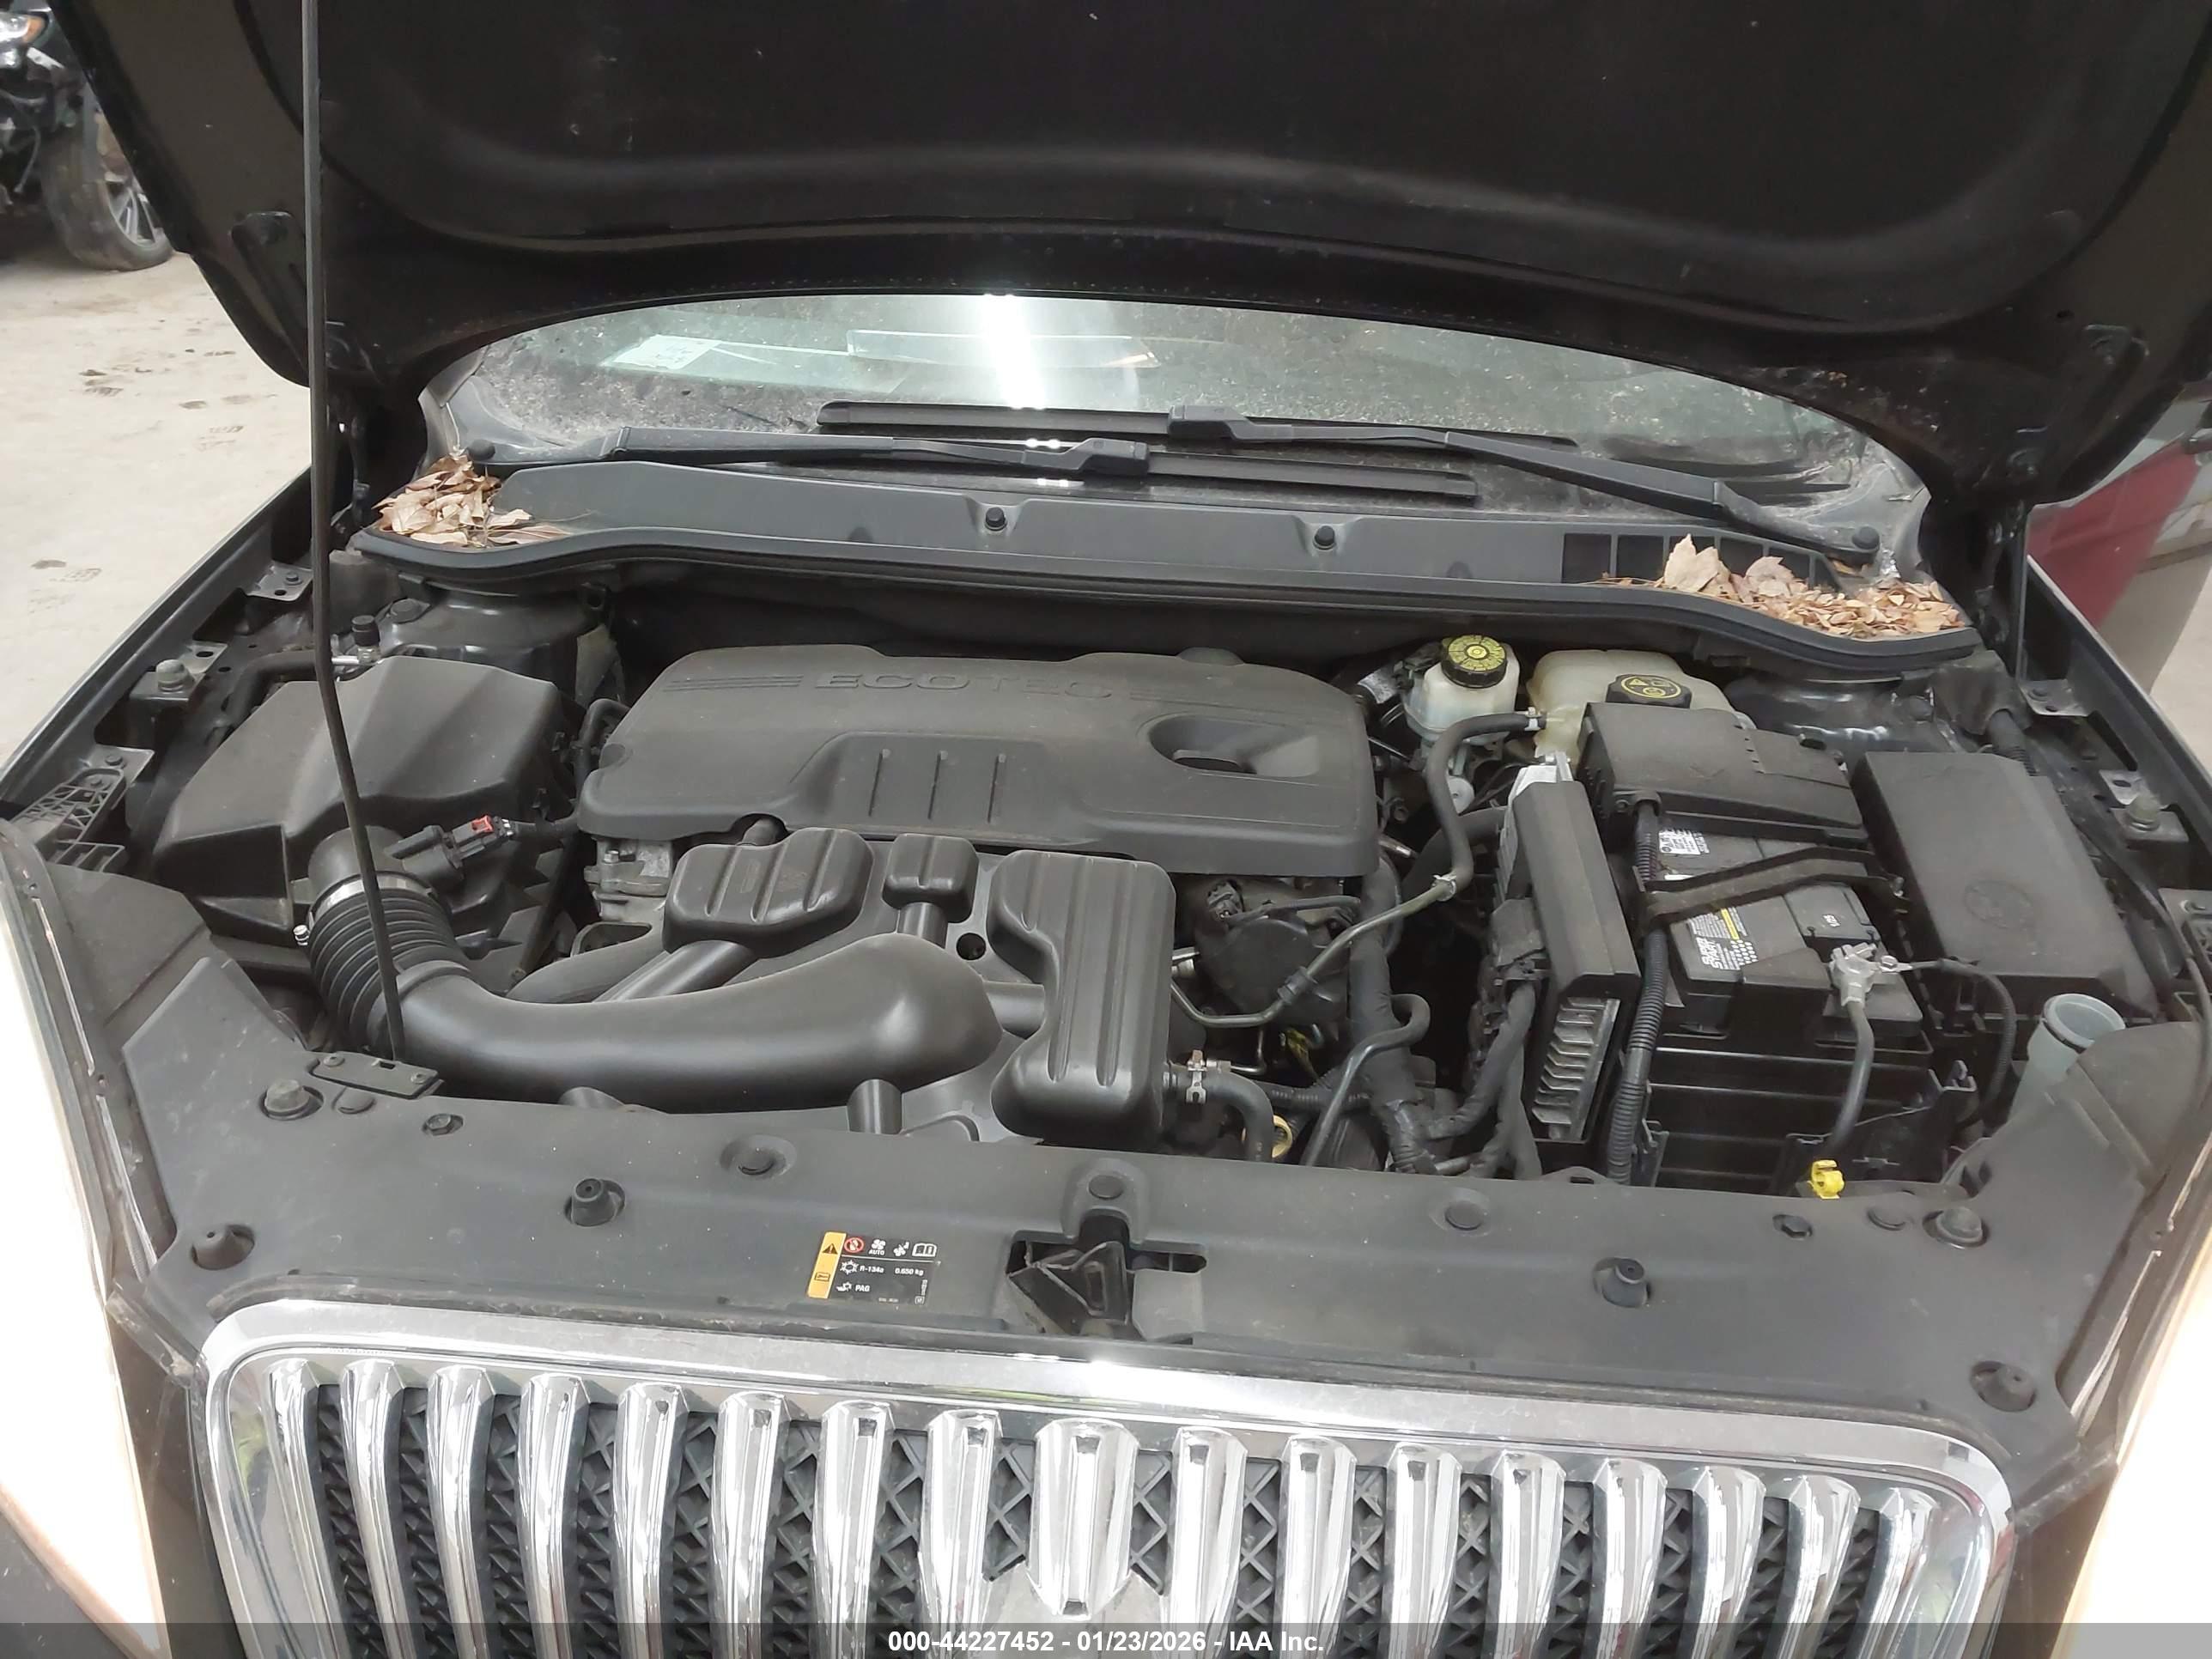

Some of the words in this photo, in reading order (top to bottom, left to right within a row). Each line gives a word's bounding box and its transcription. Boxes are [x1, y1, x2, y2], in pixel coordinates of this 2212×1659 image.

[814, 672, 1115, 699] ECOTEC
[1695, 937, 1711, 965] SUPER
[1705, 940, 1723, 969] START
